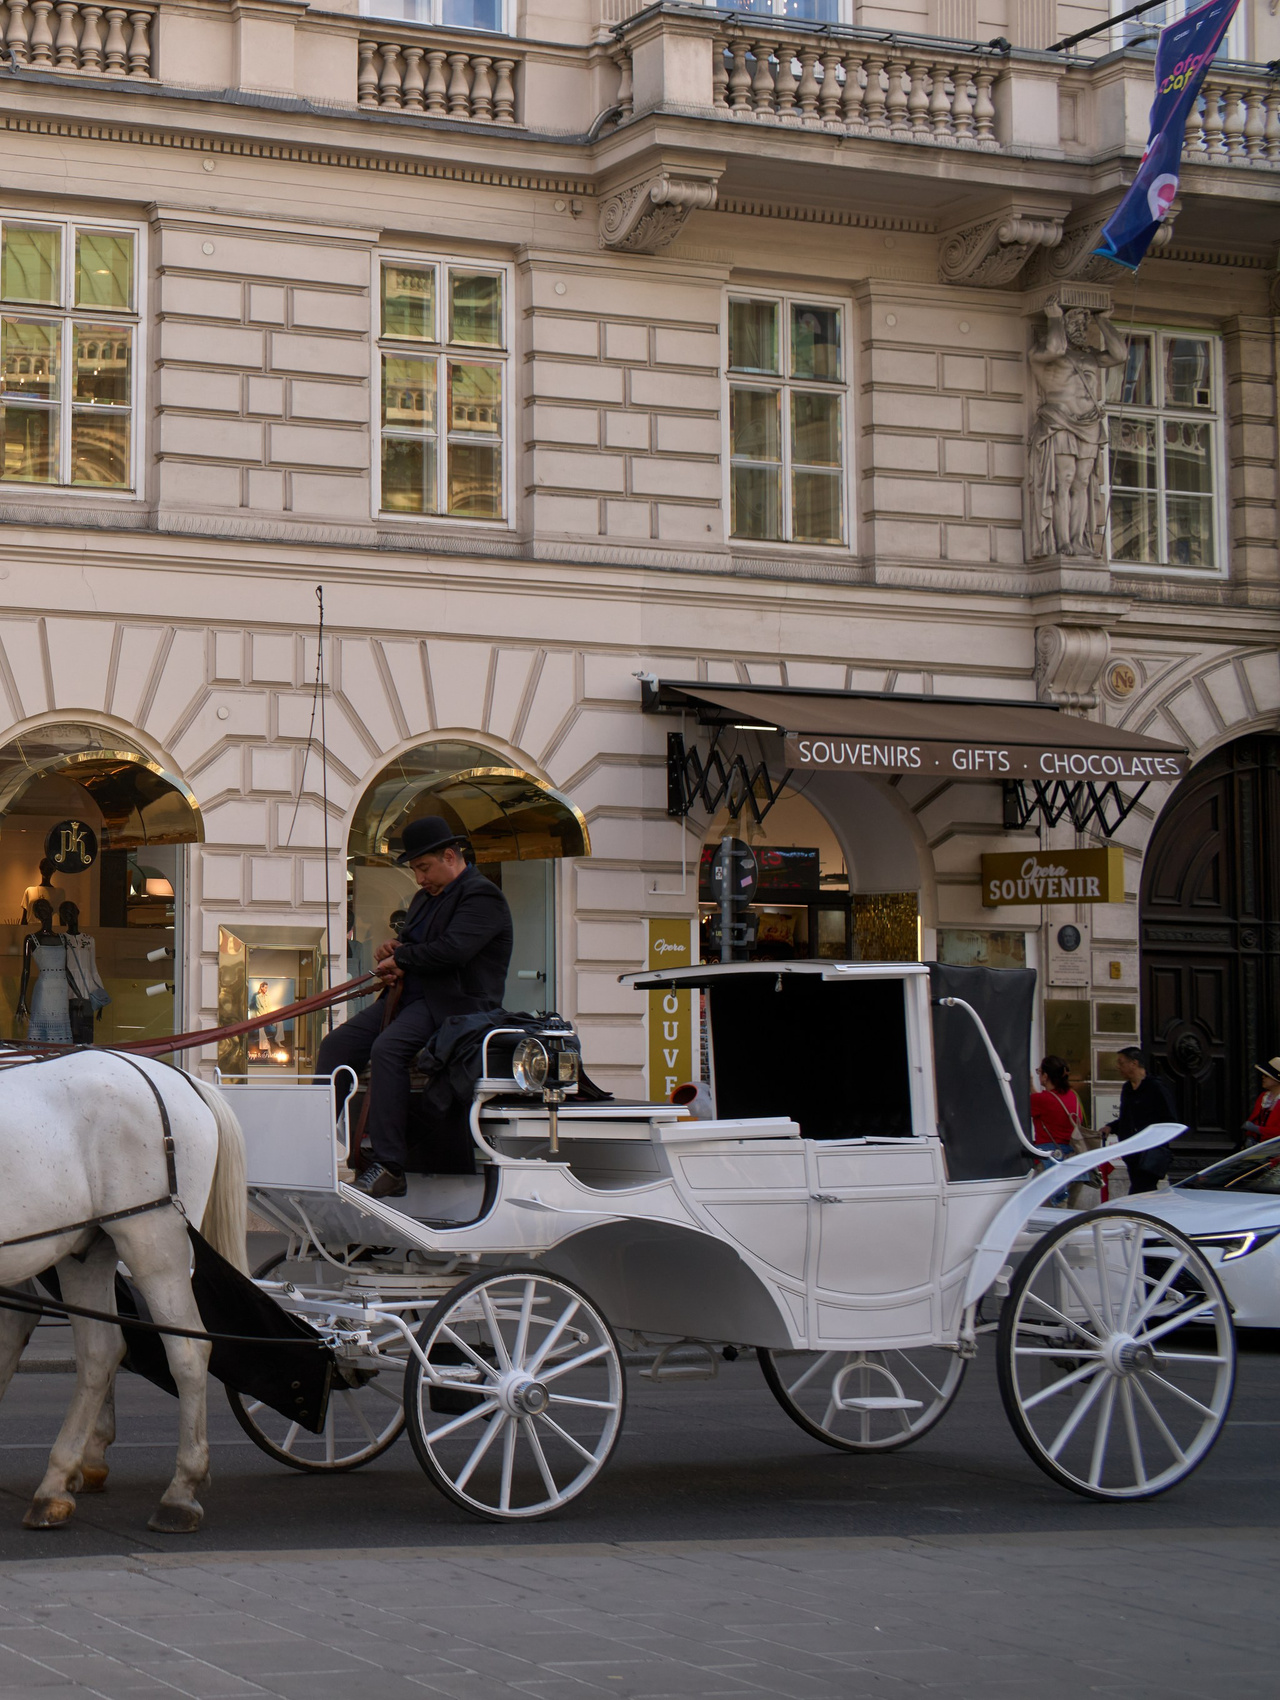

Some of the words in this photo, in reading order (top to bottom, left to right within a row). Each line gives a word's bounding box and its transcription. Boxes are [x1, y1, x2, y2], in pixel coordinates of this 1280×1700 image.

[798, 741, 922, 768] SOUVENIRS
[952, 749, 1010, 771] GIFTS
[1040, 752, 1181, 776] CHOCOLATES
[1020, 856, 1068, 884] Opera
[989, 876, 1101, 900] SOUVENIR
[653, 938, 687, 955] Opera
